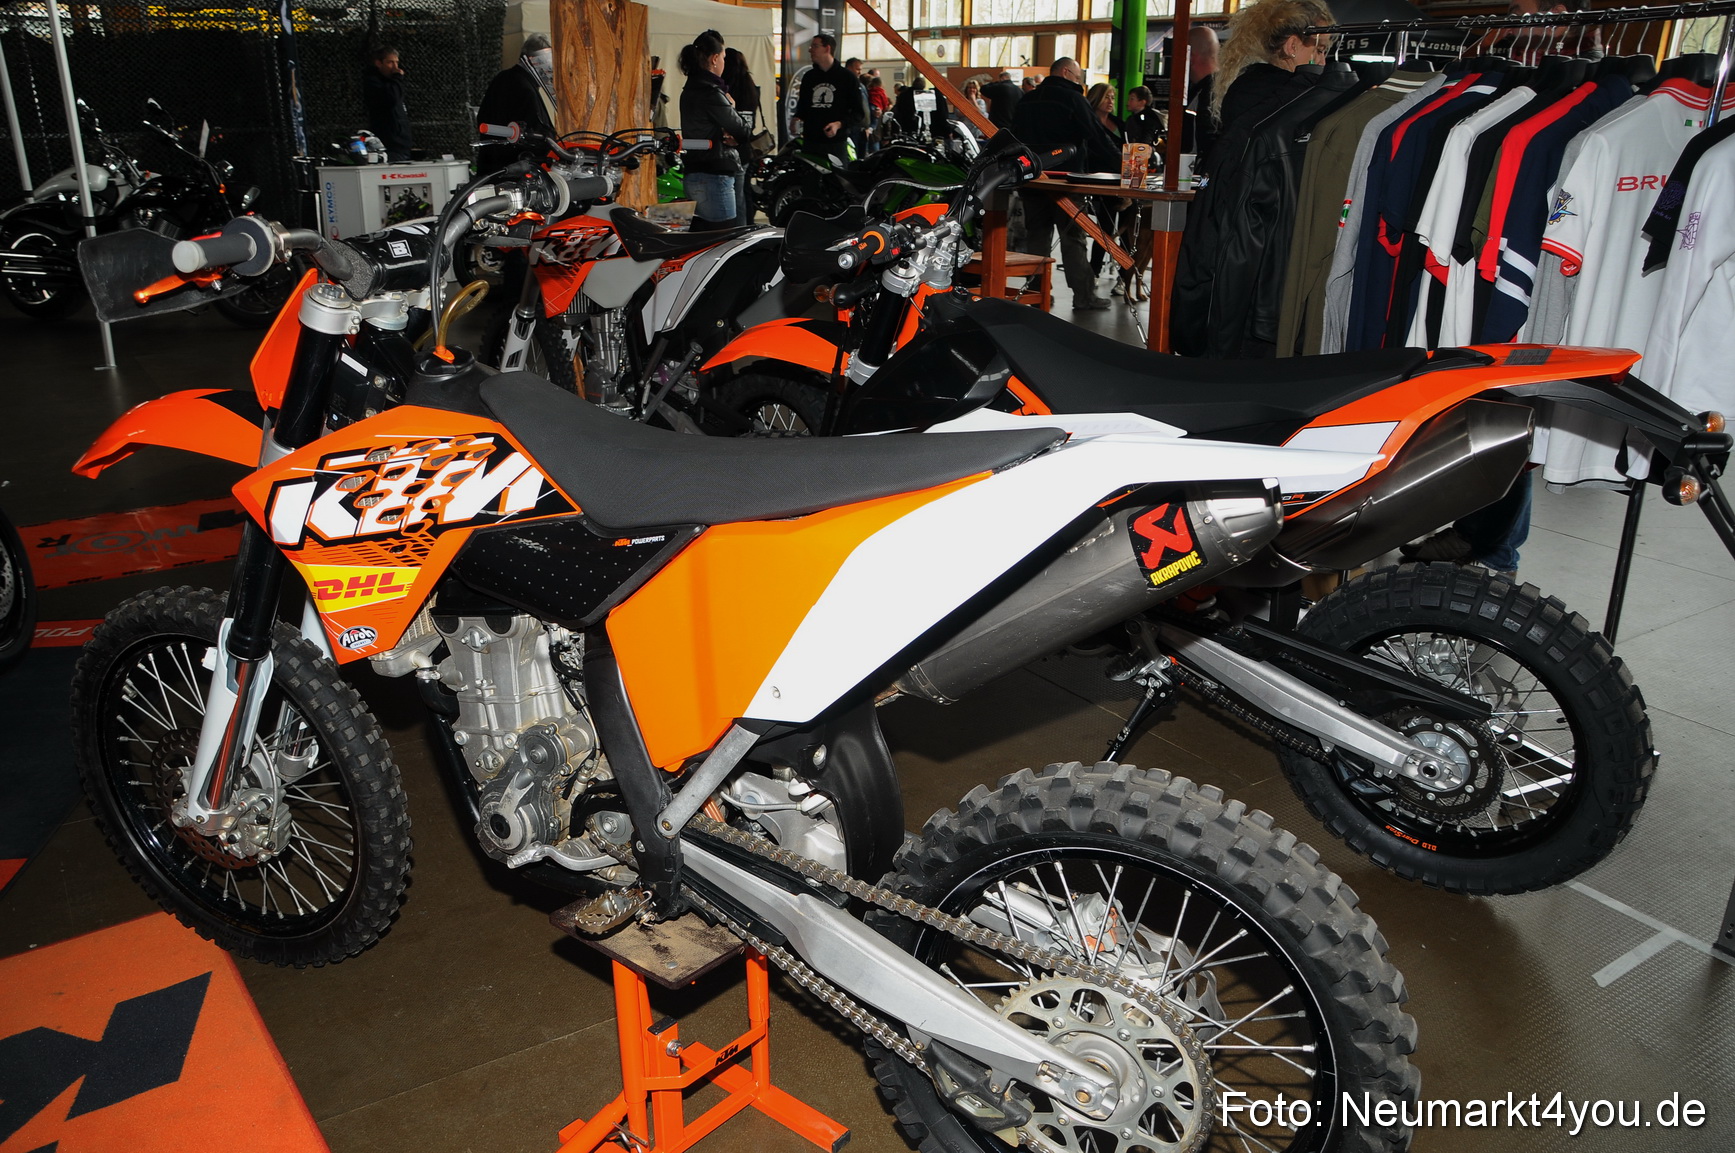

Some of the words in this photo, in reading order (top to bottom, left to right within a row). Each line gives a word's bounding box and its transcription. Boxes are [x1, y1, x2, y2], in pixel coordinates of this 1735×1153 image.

[1336, 38, 1370, 51] ERS
[325, 182, 335, 223] KYMCO
[269, 437, 545, 546] KTM
[313, 571, 405, 600] DHL
[342, 627, 376, 647] Airoh
[1421, 842, 1438, 851] DID
[715, 1044, 739, 1067] KTM
